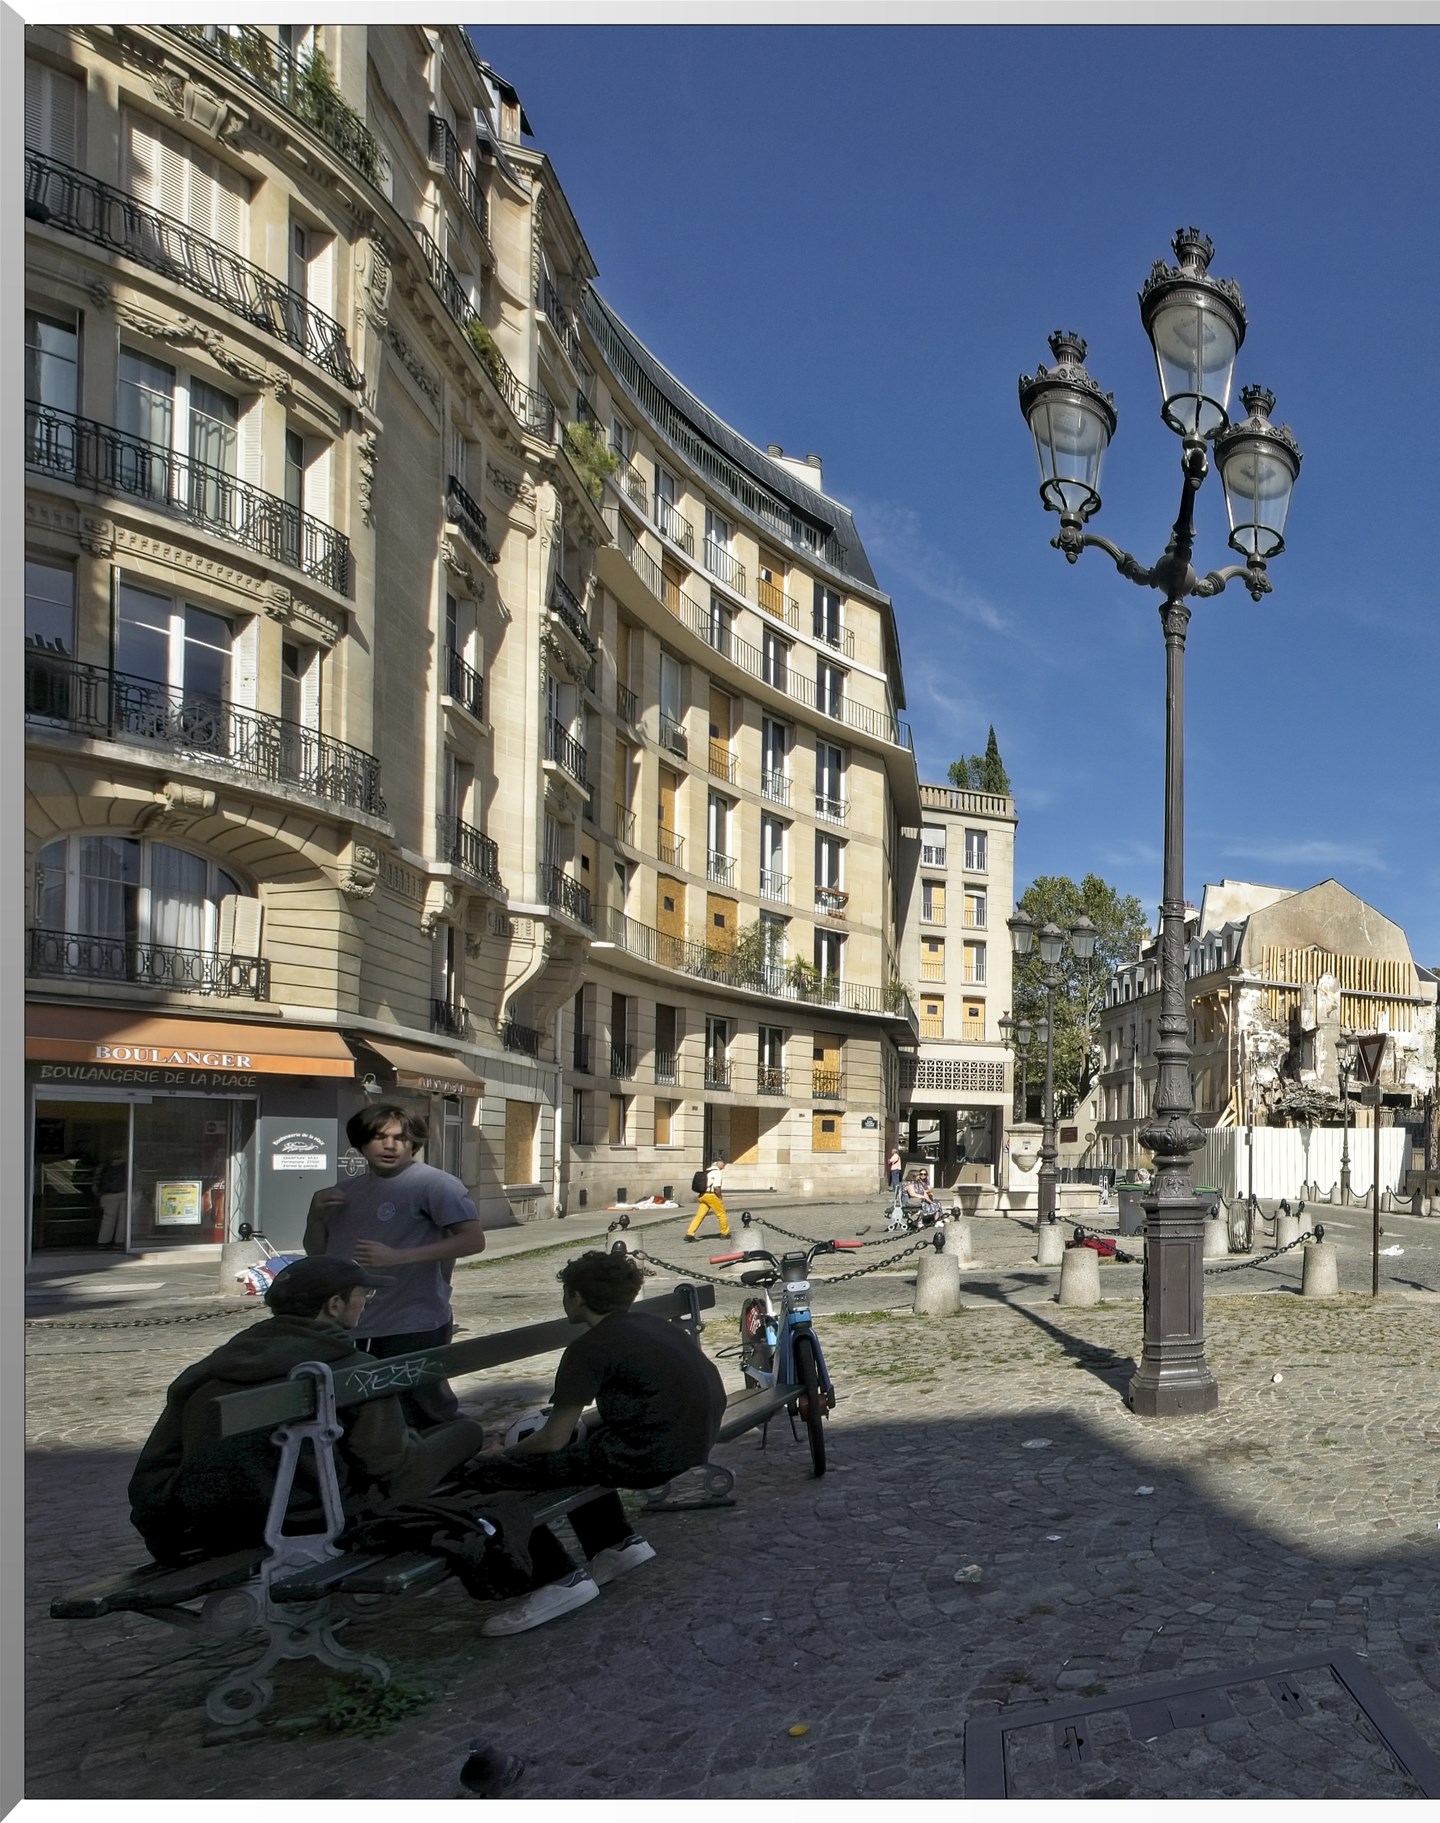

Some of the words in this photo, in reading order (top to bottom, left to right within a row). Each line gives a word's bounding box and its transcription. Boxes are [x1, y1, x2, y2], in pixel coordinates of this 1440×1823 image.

[95, 1045, 252, 1068] BOULANGER
[40, 1064, 160, 1082] BOULANGERIE
[164, 1071, 185, 1084] DE
[190, 1073, 207, 1085] LA
[212, 1073, 257, 1087] PLACE
